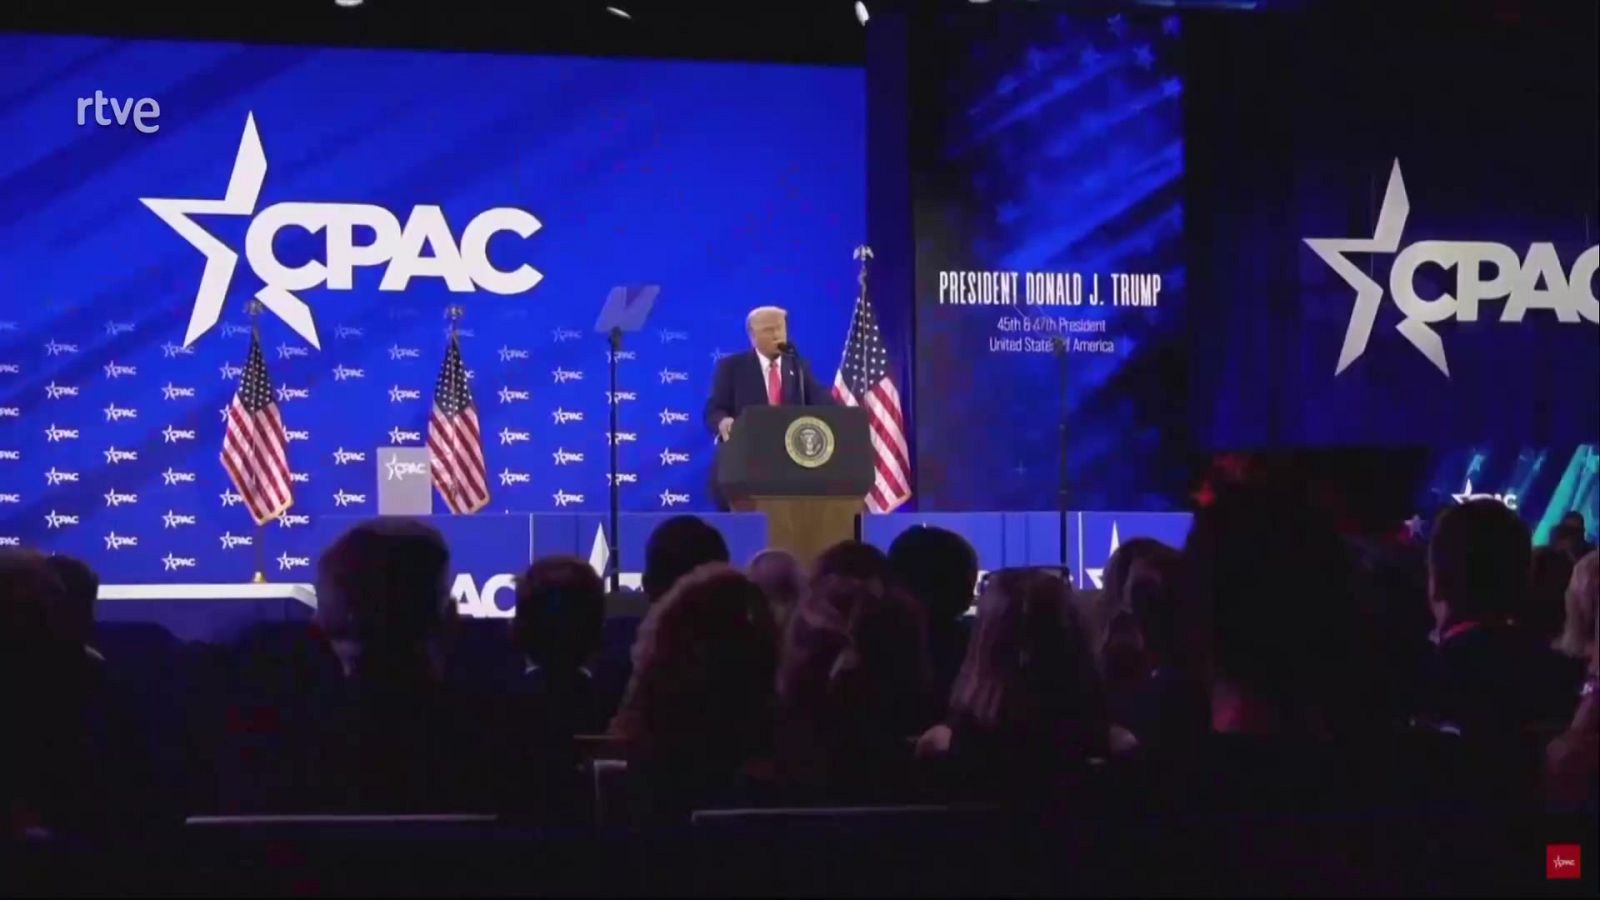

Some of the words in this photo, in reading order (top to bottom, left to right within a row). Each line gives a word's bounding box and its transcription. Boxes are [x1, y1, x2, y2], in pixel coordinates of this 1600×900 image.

[245, 202, 544, 295] CPAC
[939, 271, 1018, 305] PRESIDENT
[1026, 272, 1082, 305] DONALD
[1090, 273, 1104, 306] J.
[1111, 273, 1161, 307] TRUMP
[997, 316, 1021, 332] 45th
[1023, 316, 1031, 331] &
[1033, 316, 1057, 331] 47th
[1059, 316, 1106, 333] President
[989, 336, 1022, 352] United
[1073, 337, 1114, 352] America
[395, 462, 426, 474] CPAC
